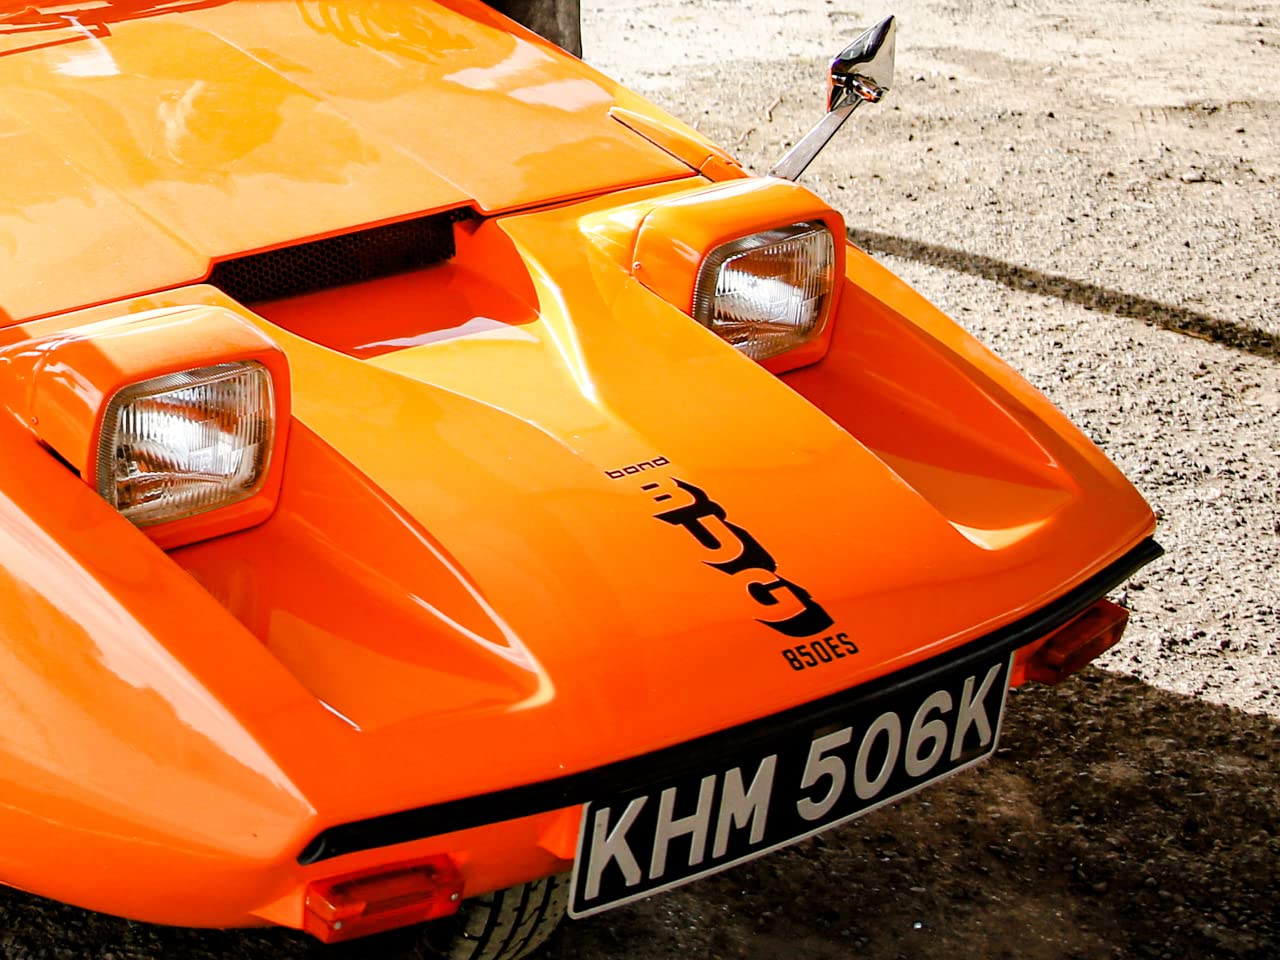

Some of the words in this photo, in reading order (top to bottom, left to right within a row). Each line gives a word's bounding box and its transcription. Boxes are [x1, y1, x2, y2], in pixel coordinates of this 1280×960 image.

[604, 456, 670, 479] bond
[782, 632, 859, 671] 850ES
[584, 754, 777, 900] KHM
[797, 663, 1002, 821] 506K
